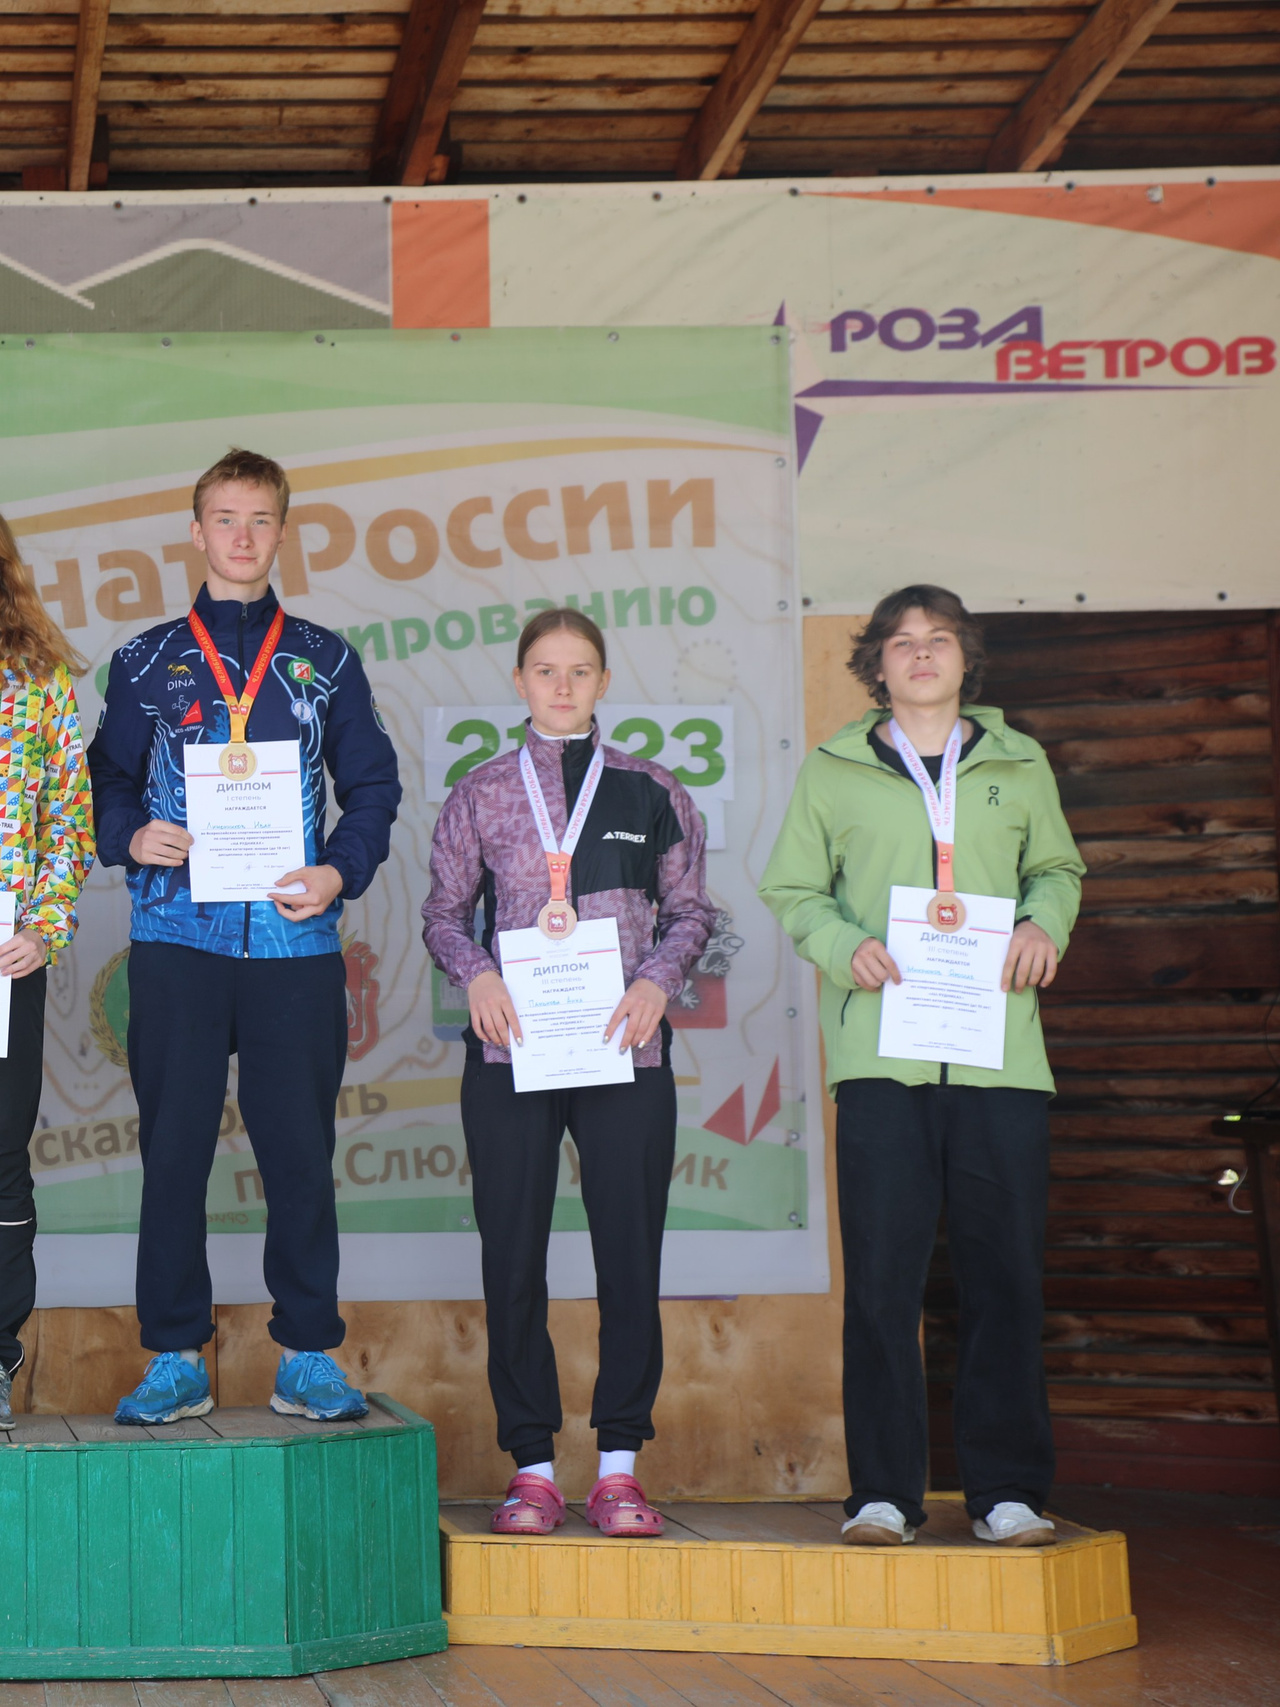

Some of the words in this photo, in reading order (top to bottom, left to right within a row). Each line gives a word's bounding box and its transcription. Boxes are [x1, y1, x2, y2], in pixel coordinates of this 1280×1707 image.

[829, 304, 1046, 353] РОЗА
[995, 336, 1277, 383] ВЕТРОВ
[167, 678, 196, 691] DINA
[216, 782, 272, 793] ДИПЛОМ
[613, 831, 647, 844] TERREX
[920, 932, 978, 947] ДИПЛОМ
[533, 962, 589, 977] ДИПЛОМ
[543, 986, 585, 994] НАГРАЖДАЕТСЯ
